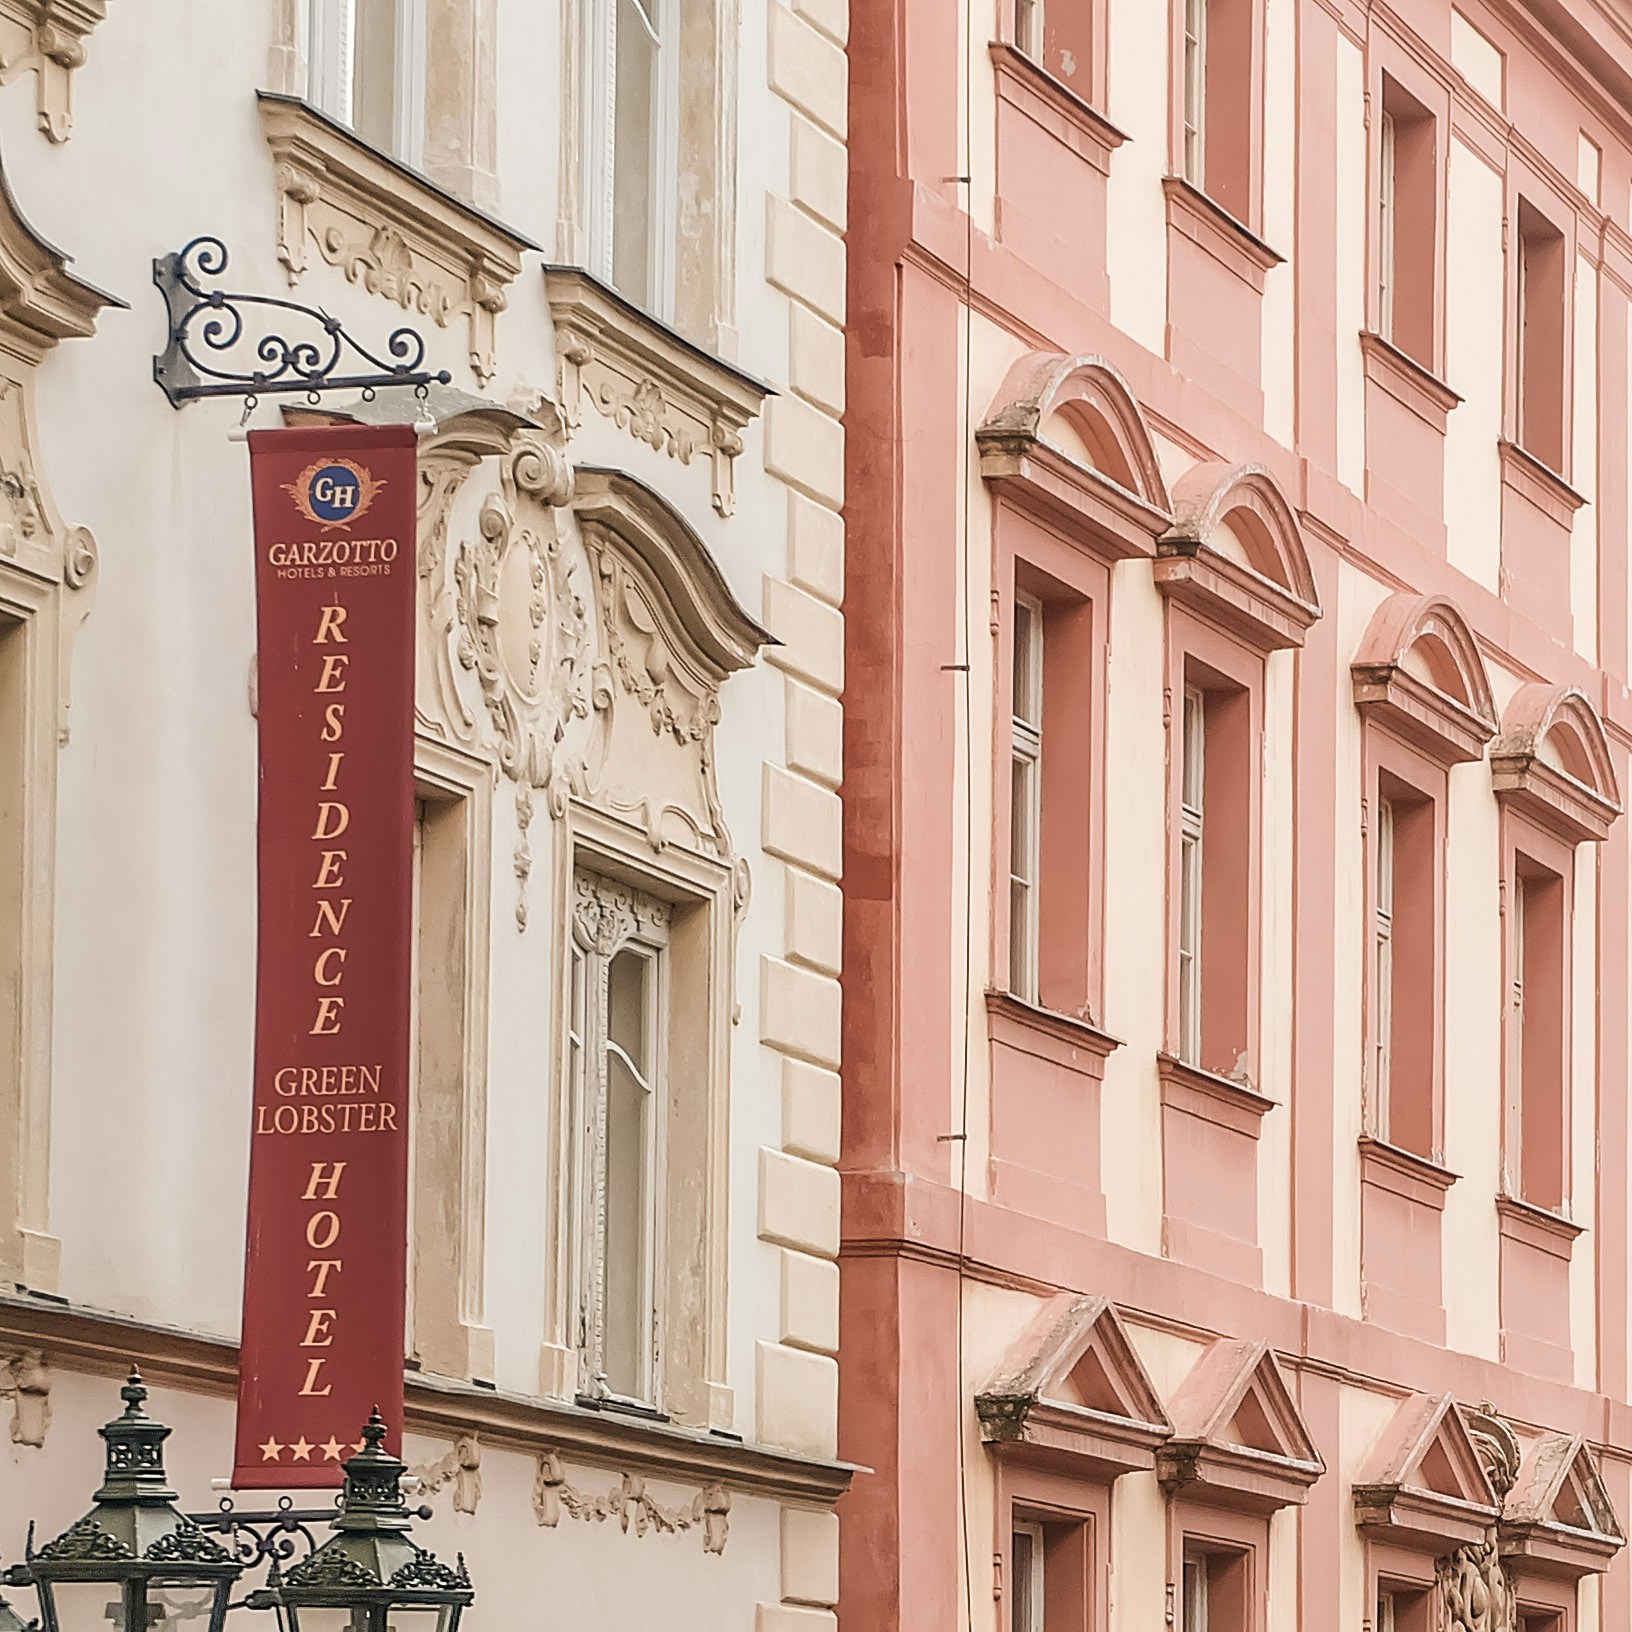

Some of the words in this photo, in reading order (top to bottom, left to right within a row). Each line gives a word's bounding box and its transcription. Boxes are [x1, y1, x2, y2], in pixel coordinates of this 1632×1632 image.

[315, 478, 355, 509] GH
[268, 539, 398, 567] GARZOTTO
[277, 567, 324, 580] HOTELS
[327, 566, 337, 578] &
[340, 564, 392, 578] RESORTS
[309, 605, 352, 1035] RESIDENCE
[274, 1065, 382, 1098] GREEN
[257, 1102, 399, 1135] LOBSTER
[298, 1161, 347, 1397] HOTEL
